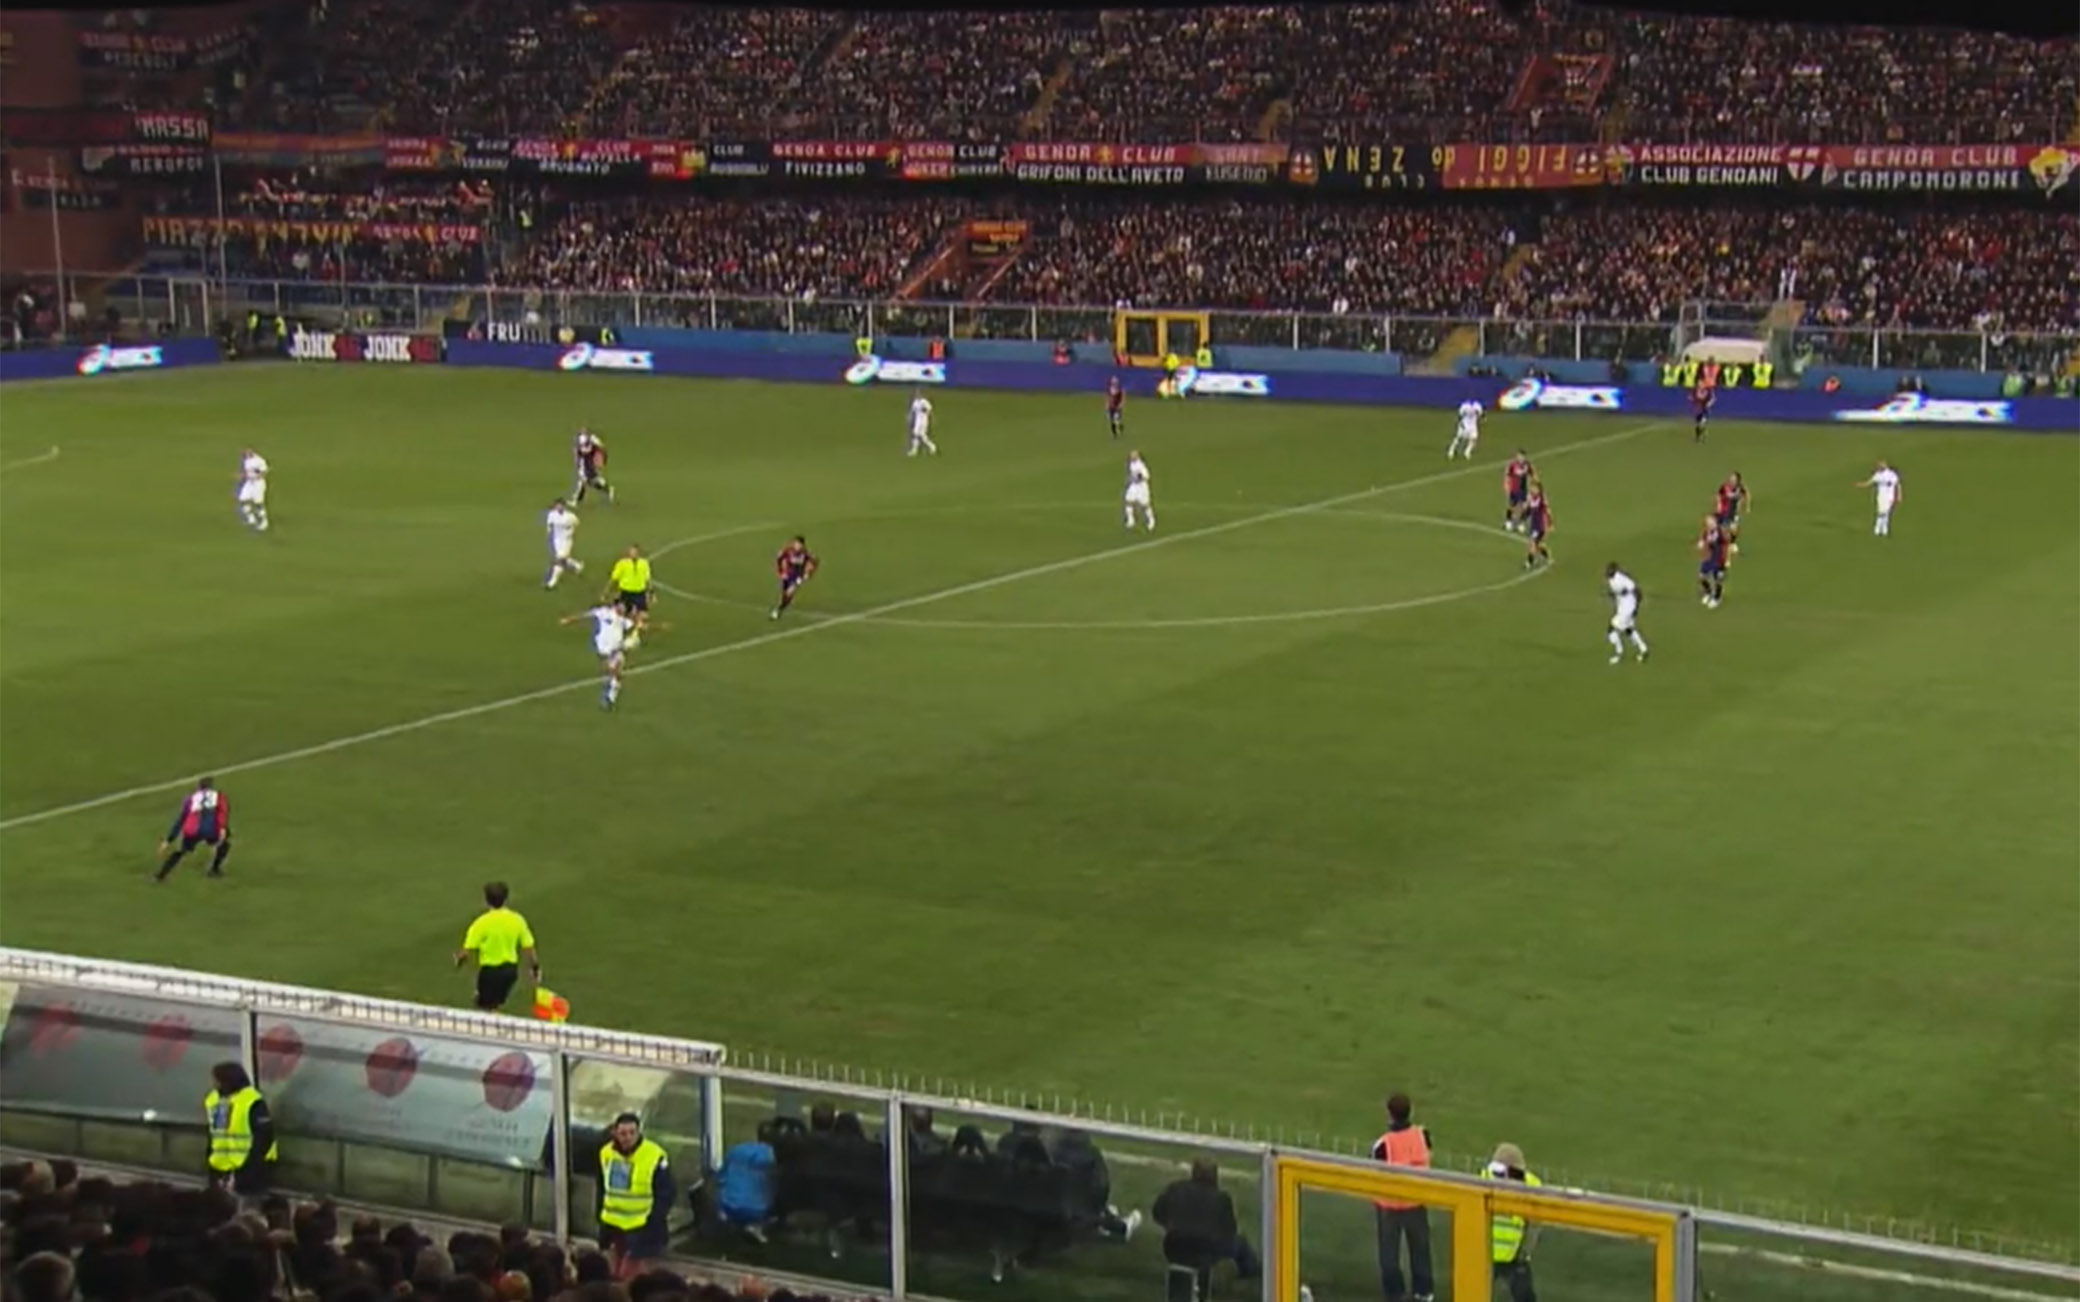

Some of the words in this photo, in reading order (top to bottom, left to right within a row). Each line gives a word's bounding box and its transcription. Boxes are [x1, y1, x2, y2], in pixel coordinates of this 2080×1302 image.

[773, 145, 827, 157] GENOA
[834, 145, 876, 157] CLUB
[958, 145, 997, 158] CLUB
[1025, 145, 1091, 161] GENOA
[1122, 147, 1176, 163] CLUB
[1323, 145, 1405, 174] ZENA
[1640, 149, 1782, 163] ASSOCIAZIONE
[1854, 147, 1935, 167] GENOA
[1950, 148, 2018, 166] CLUB
[785, 161, 866, 176] FIVIZZANO
[1017, 164, 1081, 181] GRIFONI
[1640, 165, 1691, 183] CLUB
[1696, 166, 1778, 184] GENOANI
[1842, 170, 2019, 189] CAMPOMORONE
